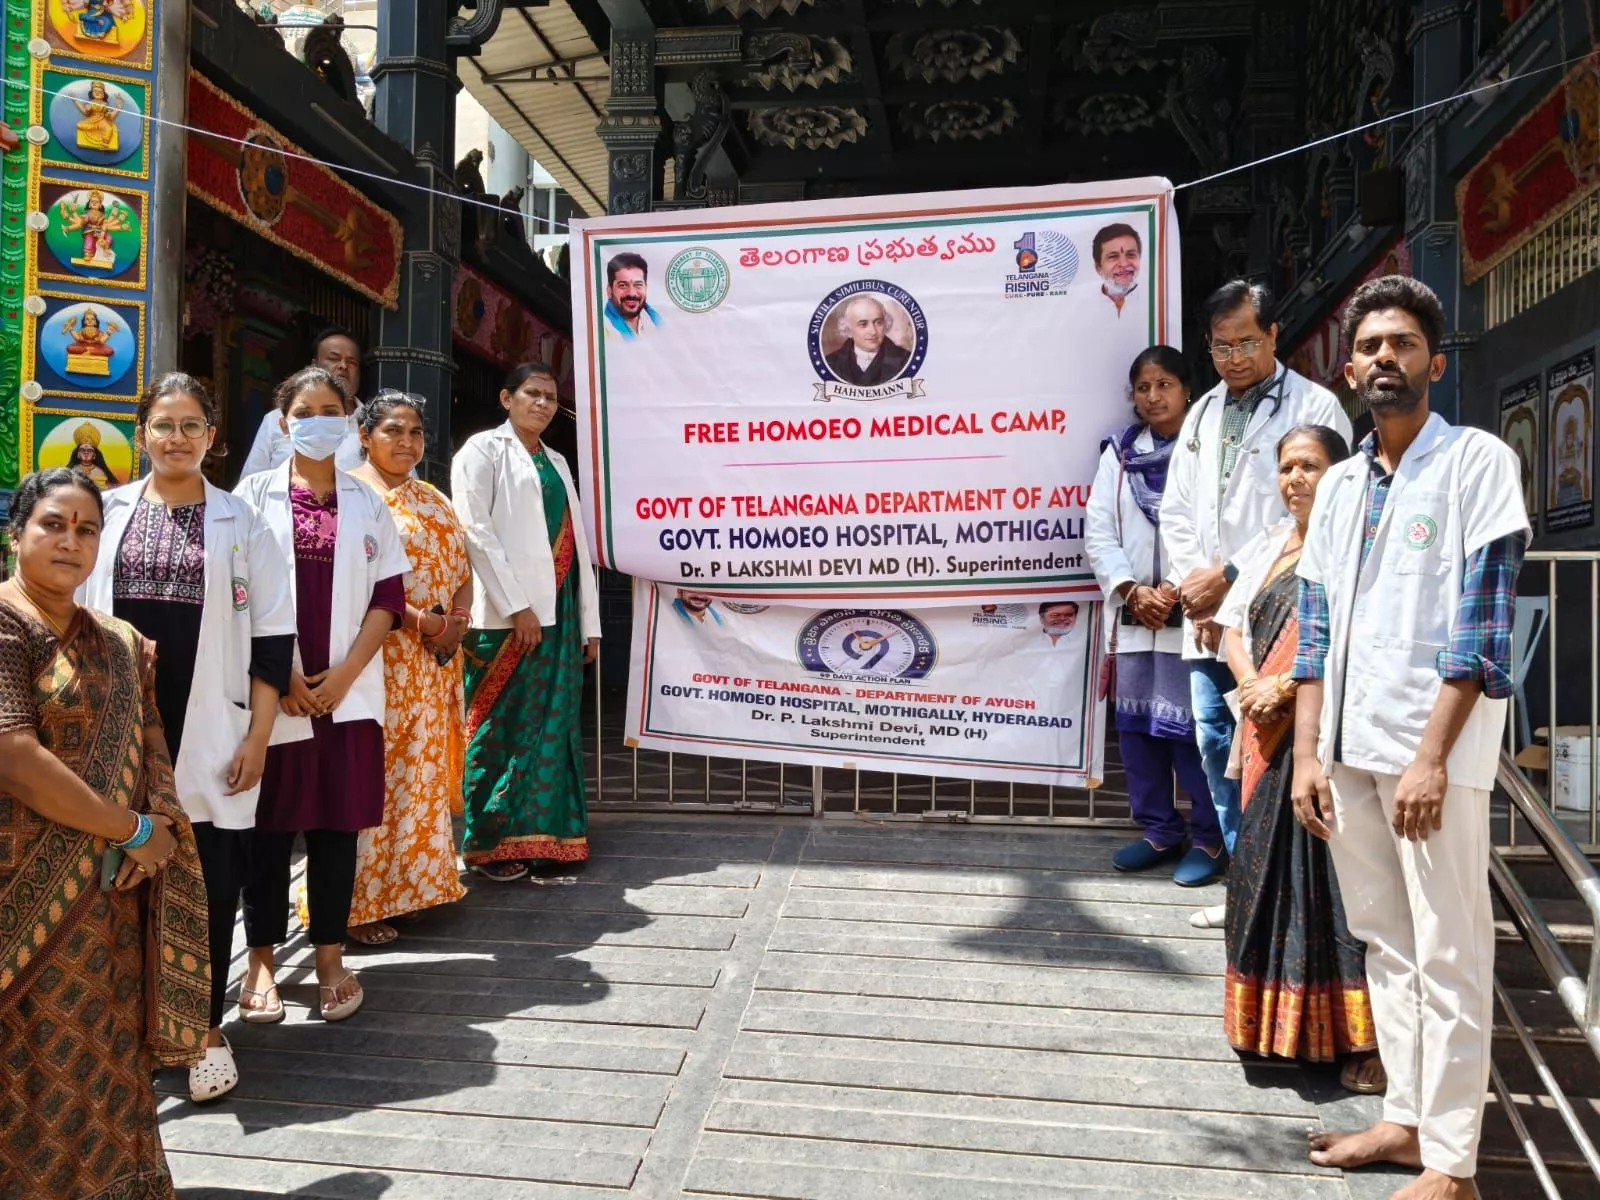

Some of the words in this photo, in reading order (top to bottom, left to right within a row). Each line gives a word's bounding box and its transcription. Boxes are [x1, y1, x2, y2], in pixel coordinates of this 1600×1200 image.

[740, 246, 849, 267] తెలంగాణ
[858, 232, 996, 266] ప్రభుత్వము
[836, 281, 885, 299] SIMILIBUS
[1005, 272, 1049, 281] TELANGANA
[1005, 281, 1049, 293] RISING
[833, 382, 904, 398] HAHNEMANN
[684, 423, 739, 444] FREE
[748, 418, 862, 442] HOMOEO
[869, 413, 984, 438] MEDICAL
[991, 409, 1066, 434] CAMP,
[636, 497, 693, 520] GOVT
[699, 496, 725, 518] OF
[732, 494, 860, 517] TELANGANA
[865, 488, 1007, 514] DEPARTMENT
[1012, 486, 1042, 509] OF
[659, 528, 722, 551] GOVT.
[729, 525, 829, 549] HOMOEO
[836, 522, 948, 548] HOSPITAL,
[680, 561, 705, 578] Dr.
[711, 561, 721, 577] P
[728, 559, 812, 578] LAKSHMI
[819, 557, 861, 576] DEVI
[869, 557, 900, 575] MD
[906, 556, 940, 577] (H).
[947, 552, 1083, 577] Superintendent
[692, 673, 730, 686] GOVT
[733, 677, 751, 687] OF
[755, 679, 841, 696] TELANGANA
[856, 688, 957, 704] DEPARTMENT
[961, 695, 980, 705] OF
[984, 697, 1036, 710] AYUSH
[660, 684, 704, 699] GOVT.
[708, 689, 775, 706] HOMOEO
[780, 696, 860, 715] HOSPITAL,
[864, 703, 968, 723] MOTHIGALLY,
[972, 712, 1073, 729] HYDERABAD
[751, 709, 774, 721] Dr.
[780, 712, 795, 723] P.
[801, 714, 873, 730] Lakshmi
[879, 721, 923, 736] Devi,
[930, 724, 959, 737] MD
[964, 727, 988, 740] (H)
[810, 728, 925, 747] Superintendent
